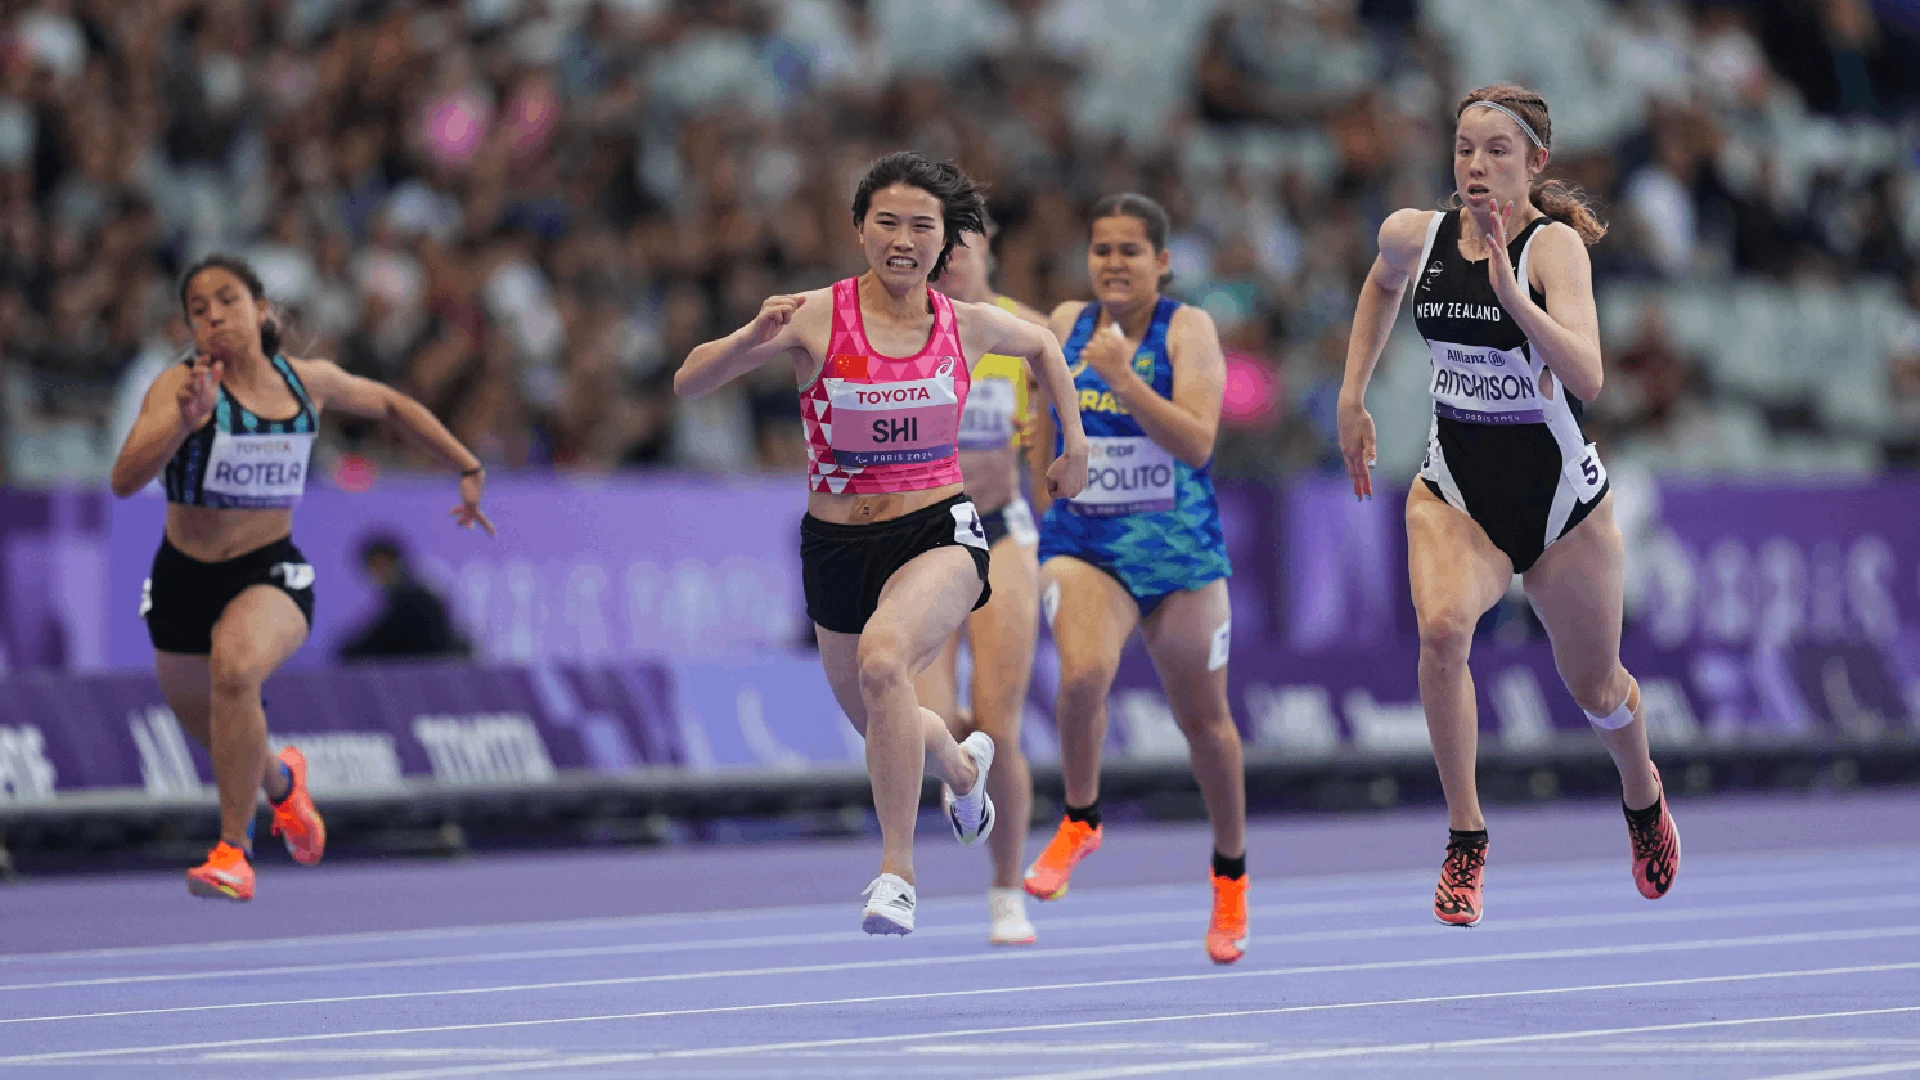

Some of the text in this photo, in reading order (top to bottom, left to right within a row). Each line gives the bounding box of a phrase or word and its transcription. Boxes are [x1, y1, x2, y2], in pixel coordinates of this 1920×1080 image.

[1416, 302, 1501, 322] NEW ZEALAND
[1446, 349, 1488, 365] Allianz
[855, 386, 932, 405] TOYOTA
[1433, 368, 1536, 401] AITCHISON
[1465, 412, 1491, 423] PARIS
[872, 417, 918, 443] SHI
[872, 453, 904, 462] PARIS
[215, 461, 302, 486] ROTELA
[1086, 464, 1171, 492] POLITO
[1579, 455, 1599, 486] 5
